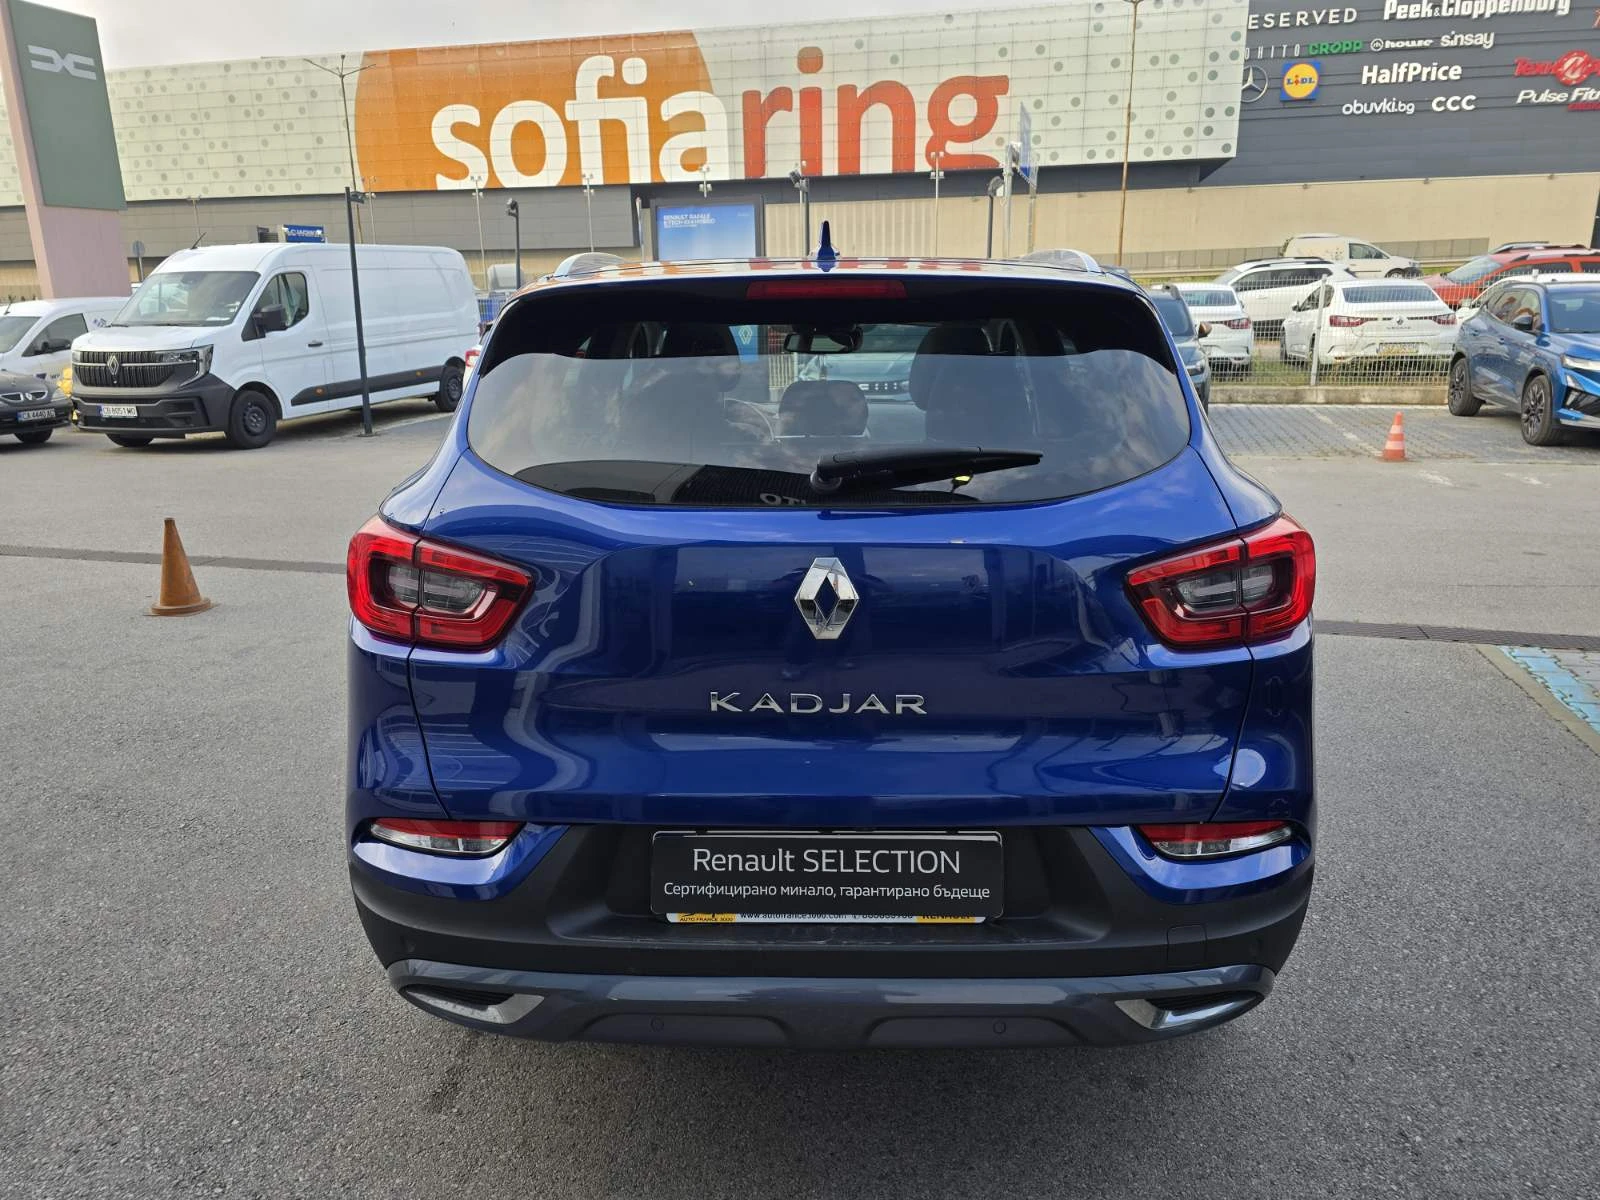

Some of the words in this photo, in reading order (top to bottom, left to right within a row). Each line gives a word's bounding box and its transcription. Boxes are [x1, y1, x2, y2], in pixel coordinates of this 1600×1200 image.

[1440, 30, 1495, 50] sinsay
[1361, 62, 1462, 85] HalfPrice
[1342, 97, 1415, 115] obuvki.bg
[1516, 88, 1568, 104] Pulse
[710, 691, 928, 715] KADJAR
[693, 848, 796, 872] Renault
[803, 849, 960, 874] SELECTION
[664, 882, 777, 898] Сертифицирано
[780, 885, 837, 898] минало,
[840, 886, 930, 900] гарантирано
[933, 884, 990, 900] бъдеще
